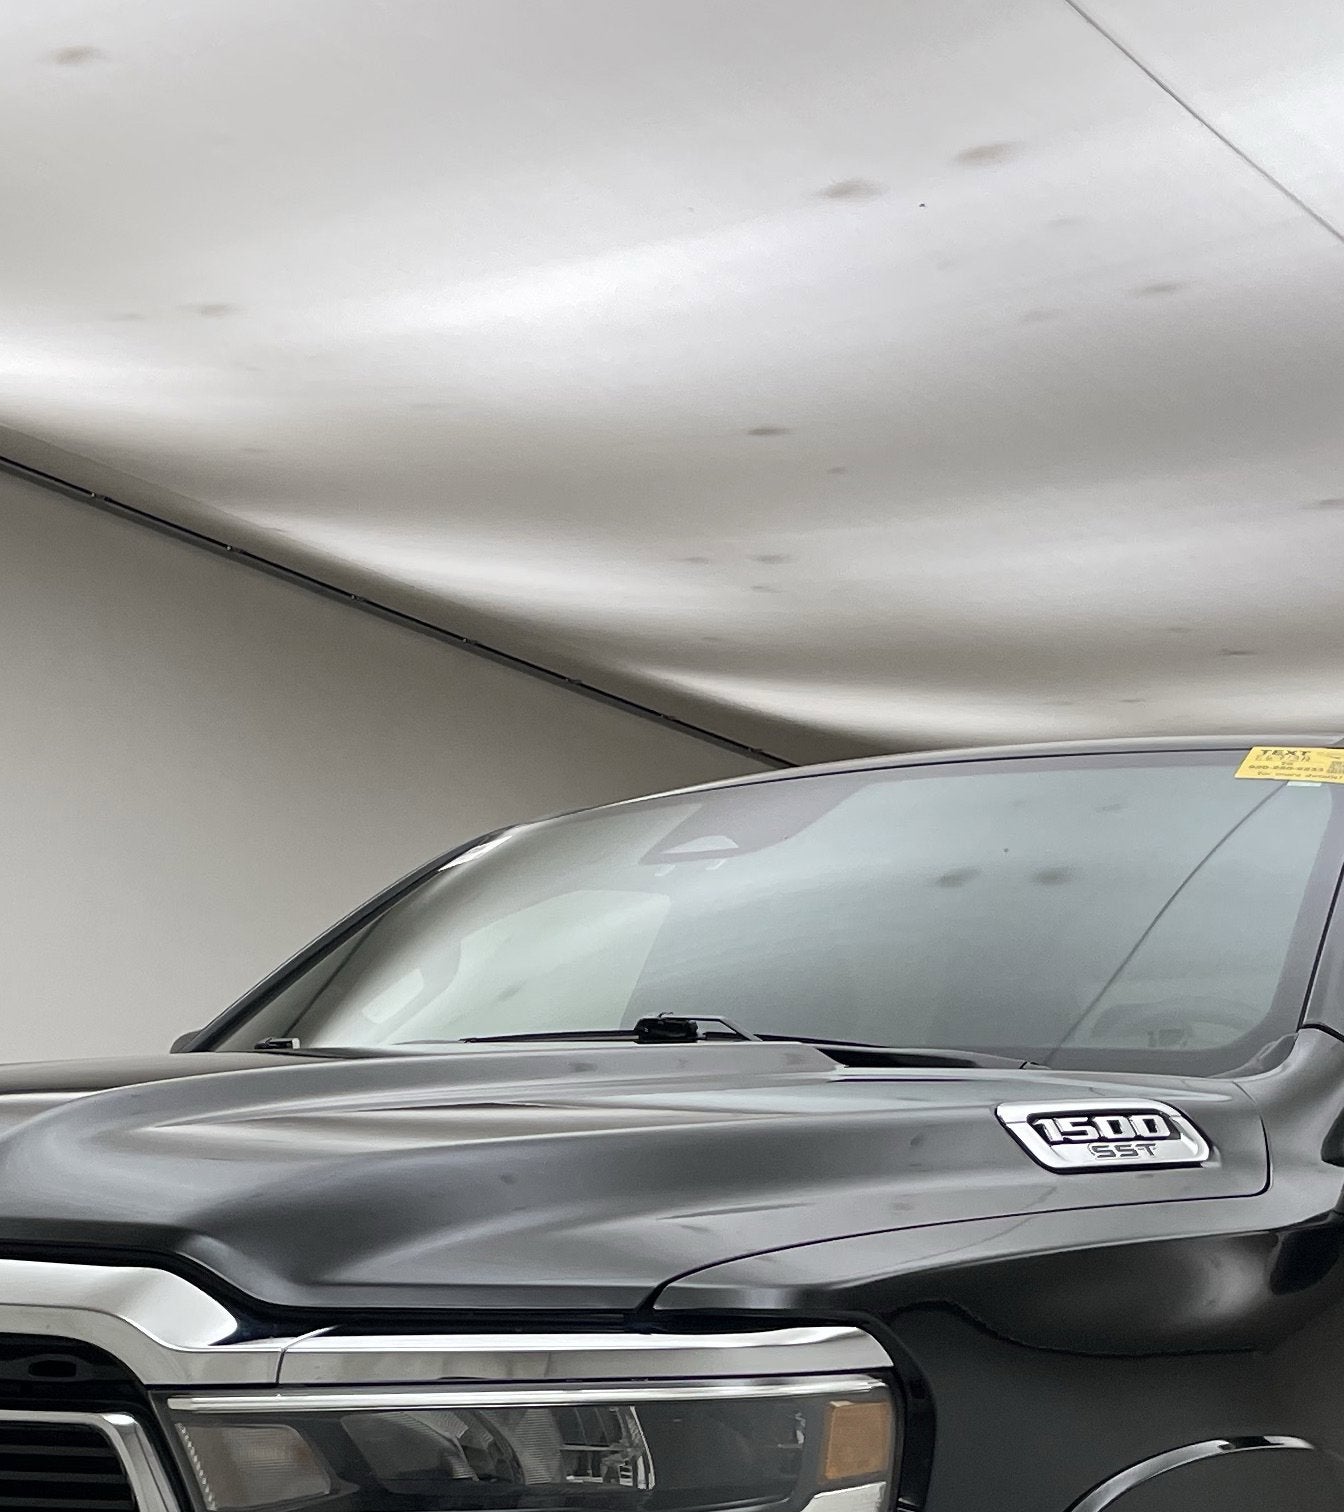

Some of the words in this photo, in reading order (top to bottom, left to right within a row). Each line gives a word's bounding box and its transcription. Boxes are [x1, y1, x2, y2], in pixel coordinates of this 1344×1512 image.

[1260, 749, 1312, 757] TEXT
[1033, 1113, 1171, 1143] 1500
[1089, 1142, 1157, 1159] SST
